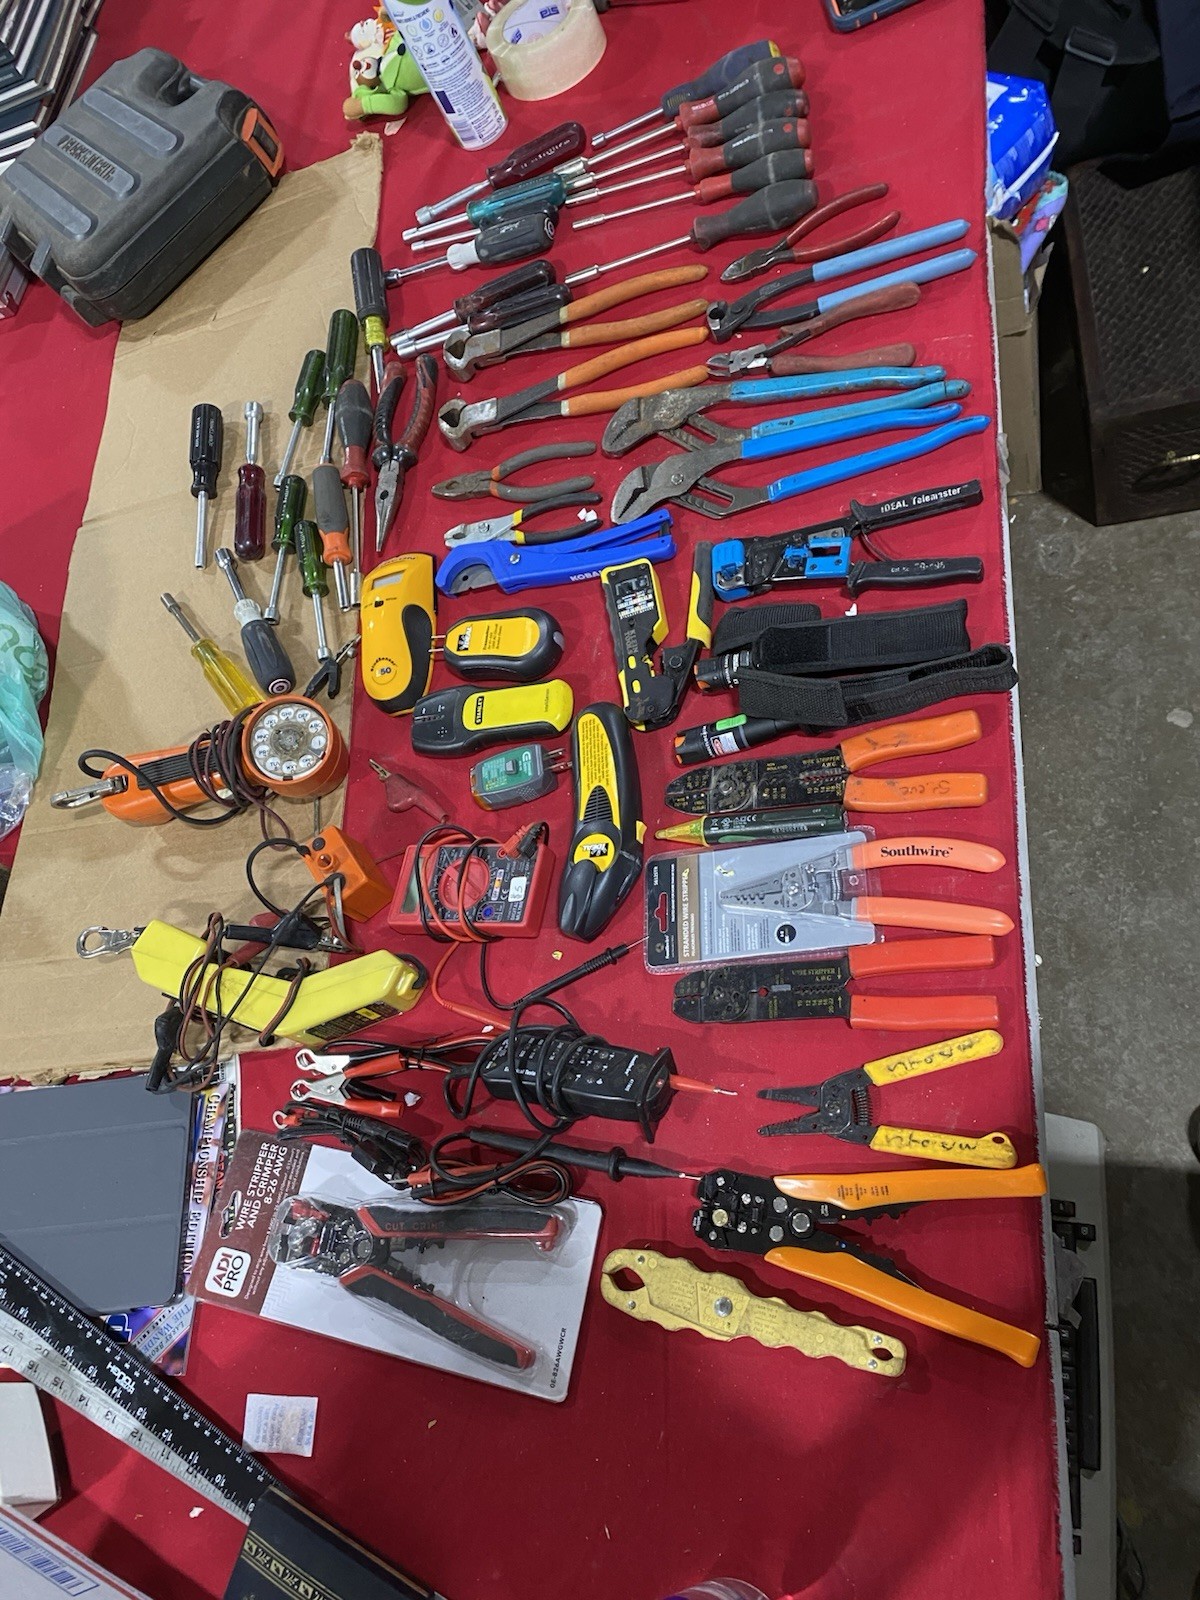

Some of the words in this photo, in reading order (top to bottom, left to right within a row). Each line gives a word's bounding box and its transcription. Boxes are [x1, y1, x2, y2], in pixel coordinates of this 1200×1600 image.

[881, 499, 909, 513] IDEAL
[569, 570, 602, 582] KOBA
[624, 630, 635, 655] TOOLS
[629, 630, 638, 654] KLEIN
[475, 697, 484, 724] STANLEY
[880, 845, 950, 858] Southwire
[682, 902, 690, 920] WIRE
[682, 921, 690, 957] STRANDED
[194, 1091, 222, 1204] CHAMPIONSHIP
[263, 1177, 278, 1205] 8-26
[271, 1146, 288, 1177] AWG
[235, 1200, 252, 1231] WIRE
[249, 1142, 270, 1201] STRIPPER
[247, 1199, 262, 1229] AND
[257, 1144, 279, 1199] CRIMPER
[385, 1222, 405, 1231] CUT
[183, 1209, 202, 1275] EDITION
[212, 1252, 233, 1288] ADI
[223, 1255, 244, 1292] PRO
[19, 1306, 29, 1318] 18
[171, 1303, 192, 1324] THE
[41, 1326, 51, 1337] 17
[141, 1322, 173, 1354] WANDE
[163, 1321, 186, 1343] LARRY
[3, 1345, 13, 1357] 17
[64, 1345, 74, 1357] 16
[146, 1341, 166, 1361] BROW
[27, 1360, 39, 1374] 16
[88, 1365, 98, 1377] 15
[52, 1377, 64, 1390] 15
[112, 1386, 122, 1398] 14
[79, 1394, 91, 1406] 14
[105, 1410, 117, 1424] 13
[137, 1407, 147, 1419] 13
[130, 1427, 143, 1442] 12
[162, 1429, 173, 1442] 12
[189, 1451, 200, 1464] 11
[215, 1474, 226, 1487] 10
